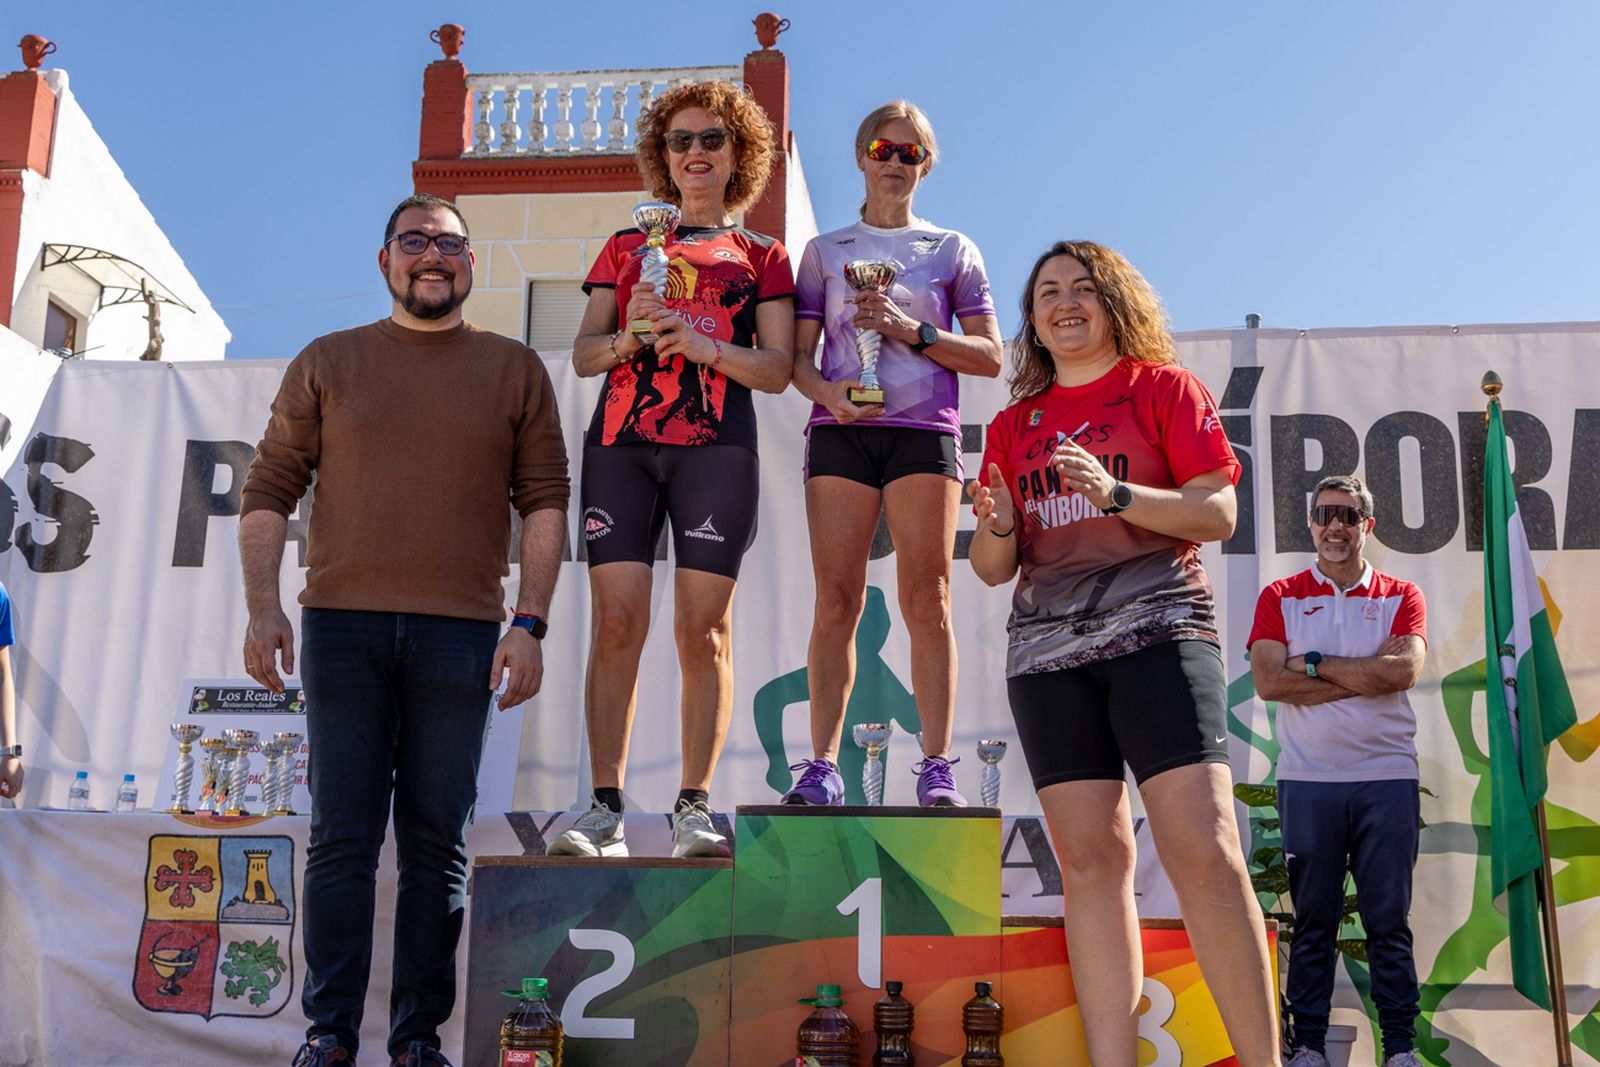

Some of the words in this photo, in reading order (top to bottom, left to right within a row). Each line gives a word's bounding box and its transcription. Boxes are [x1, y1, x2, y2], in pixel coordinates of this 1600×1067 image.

[676, 308, 716, 333] tive
[217, 689, 241, 701] Los
[244, 689, 286, 702] Reales
[836, 877, 882, 989] 1
[561, 928, 635, 1040] 2
